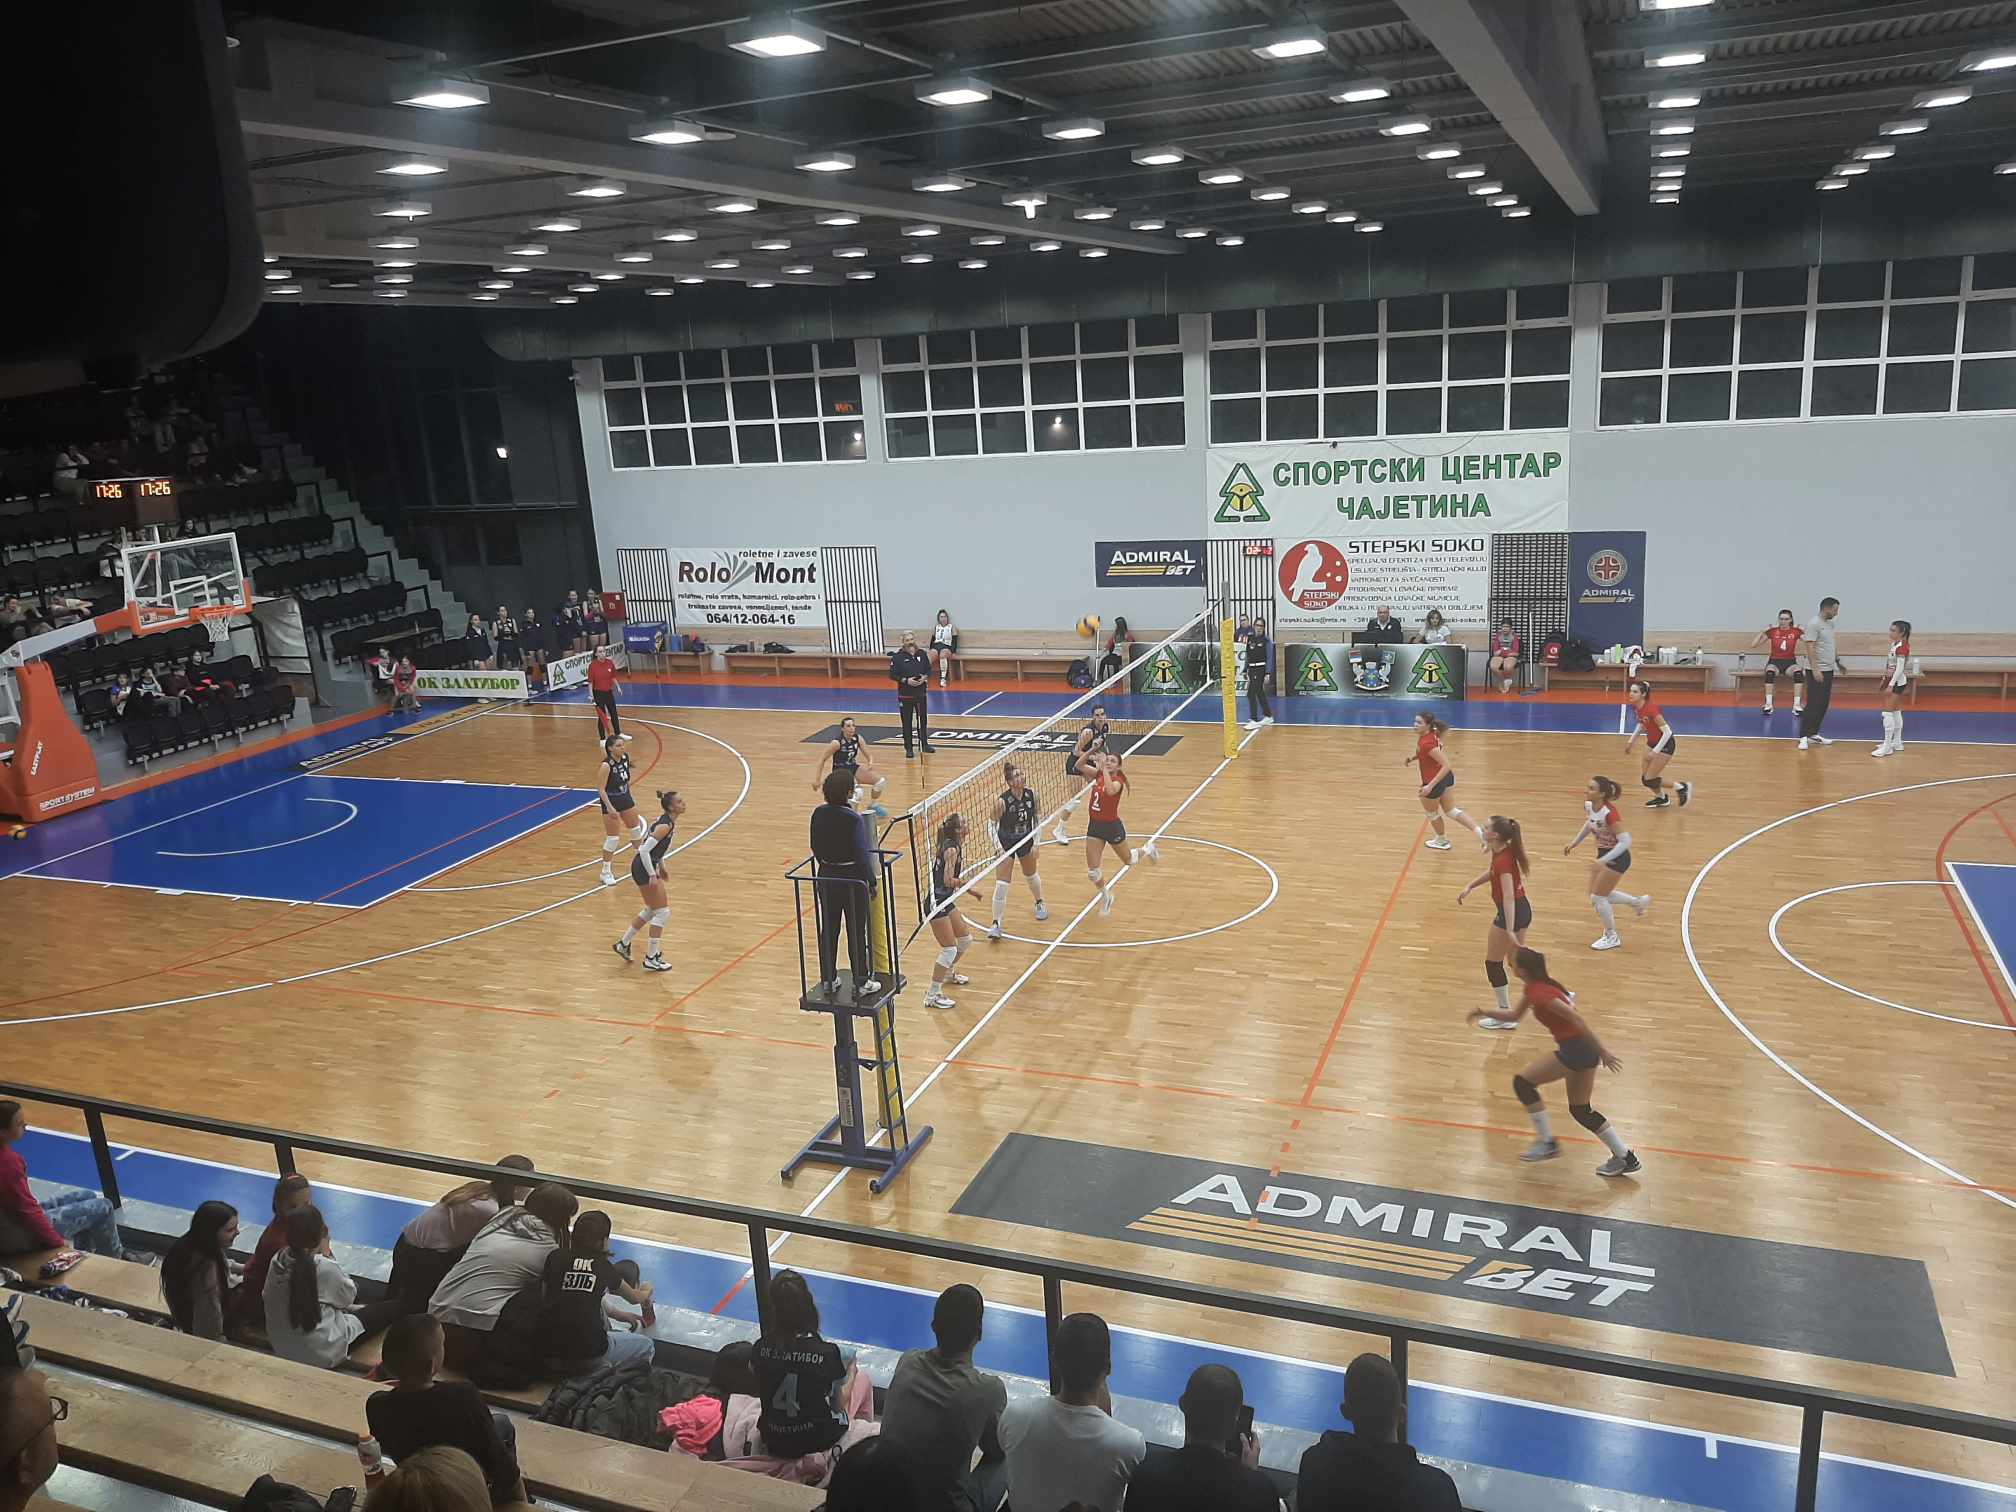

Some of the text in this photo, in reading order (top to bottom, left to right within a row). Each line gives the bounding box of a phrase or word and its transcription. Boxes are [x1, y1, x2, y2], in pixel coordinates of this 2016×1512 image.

[1272, 452, 1562, 487] СПОРТСКИ ЦЕНТАР
[95, 484, 122, 498] 17:26
[141, 481, 171, 496] 17:26
[1337, 493, 1492, 520] ЧАЈЕТИНА
[1348, 538, 1484, 554] STEPSKI SOKO
[738, 550, 774, 558] roletne
[1111, 549, 1196, 565] ADMIRAL
[678, 561, 817, 584] Rolo Mont
[1165, 565, 1195, 576] BET
[1303, 591, 1340, 600] STEPSKI
[1582, 588, 1635, 596] ADMIRAL
[1303, 600, 1329, 608] SOKO
[706, 612, 796, 625] 064/12-064-16
[1780, 639, 1787, 650] 4
[417, 677, 520, 690] ОК ЗЛАТИБОР
[1171, 1173, 1656, 1277] ADMIRAL
[1464, 1259, 1655, 1307] BET
[772, 1372, 801, 1418] 4
